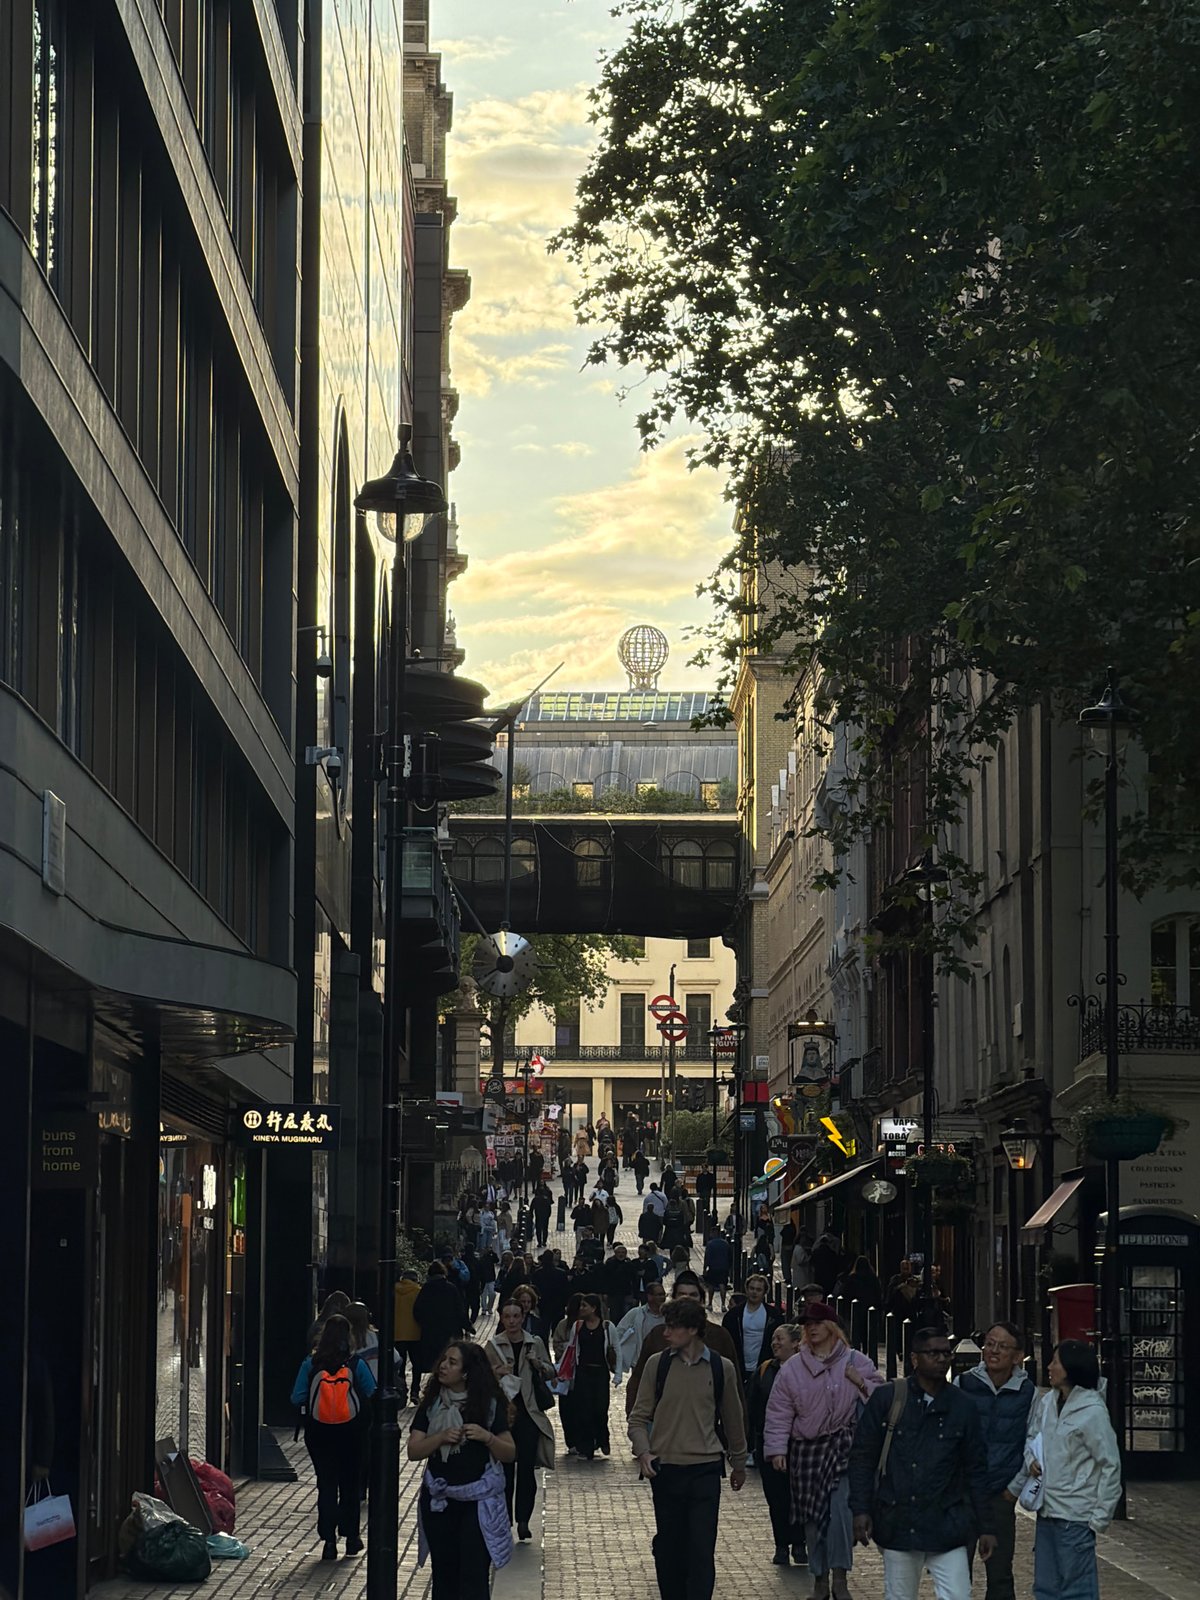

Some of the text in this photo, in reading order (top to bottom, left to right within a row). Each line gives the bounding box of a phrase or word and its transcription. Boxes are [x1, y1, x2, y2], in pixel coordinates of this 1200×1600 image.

[42, 1129, 76, 1141] buns
[253, 1134, 323, 1144] KINEYA MUGIMARU
[42, 1145, 73, 1156] from
[42, 1160, 81, 1172] home
[1121, 1235, 1186, 1245] TELEPHONE
